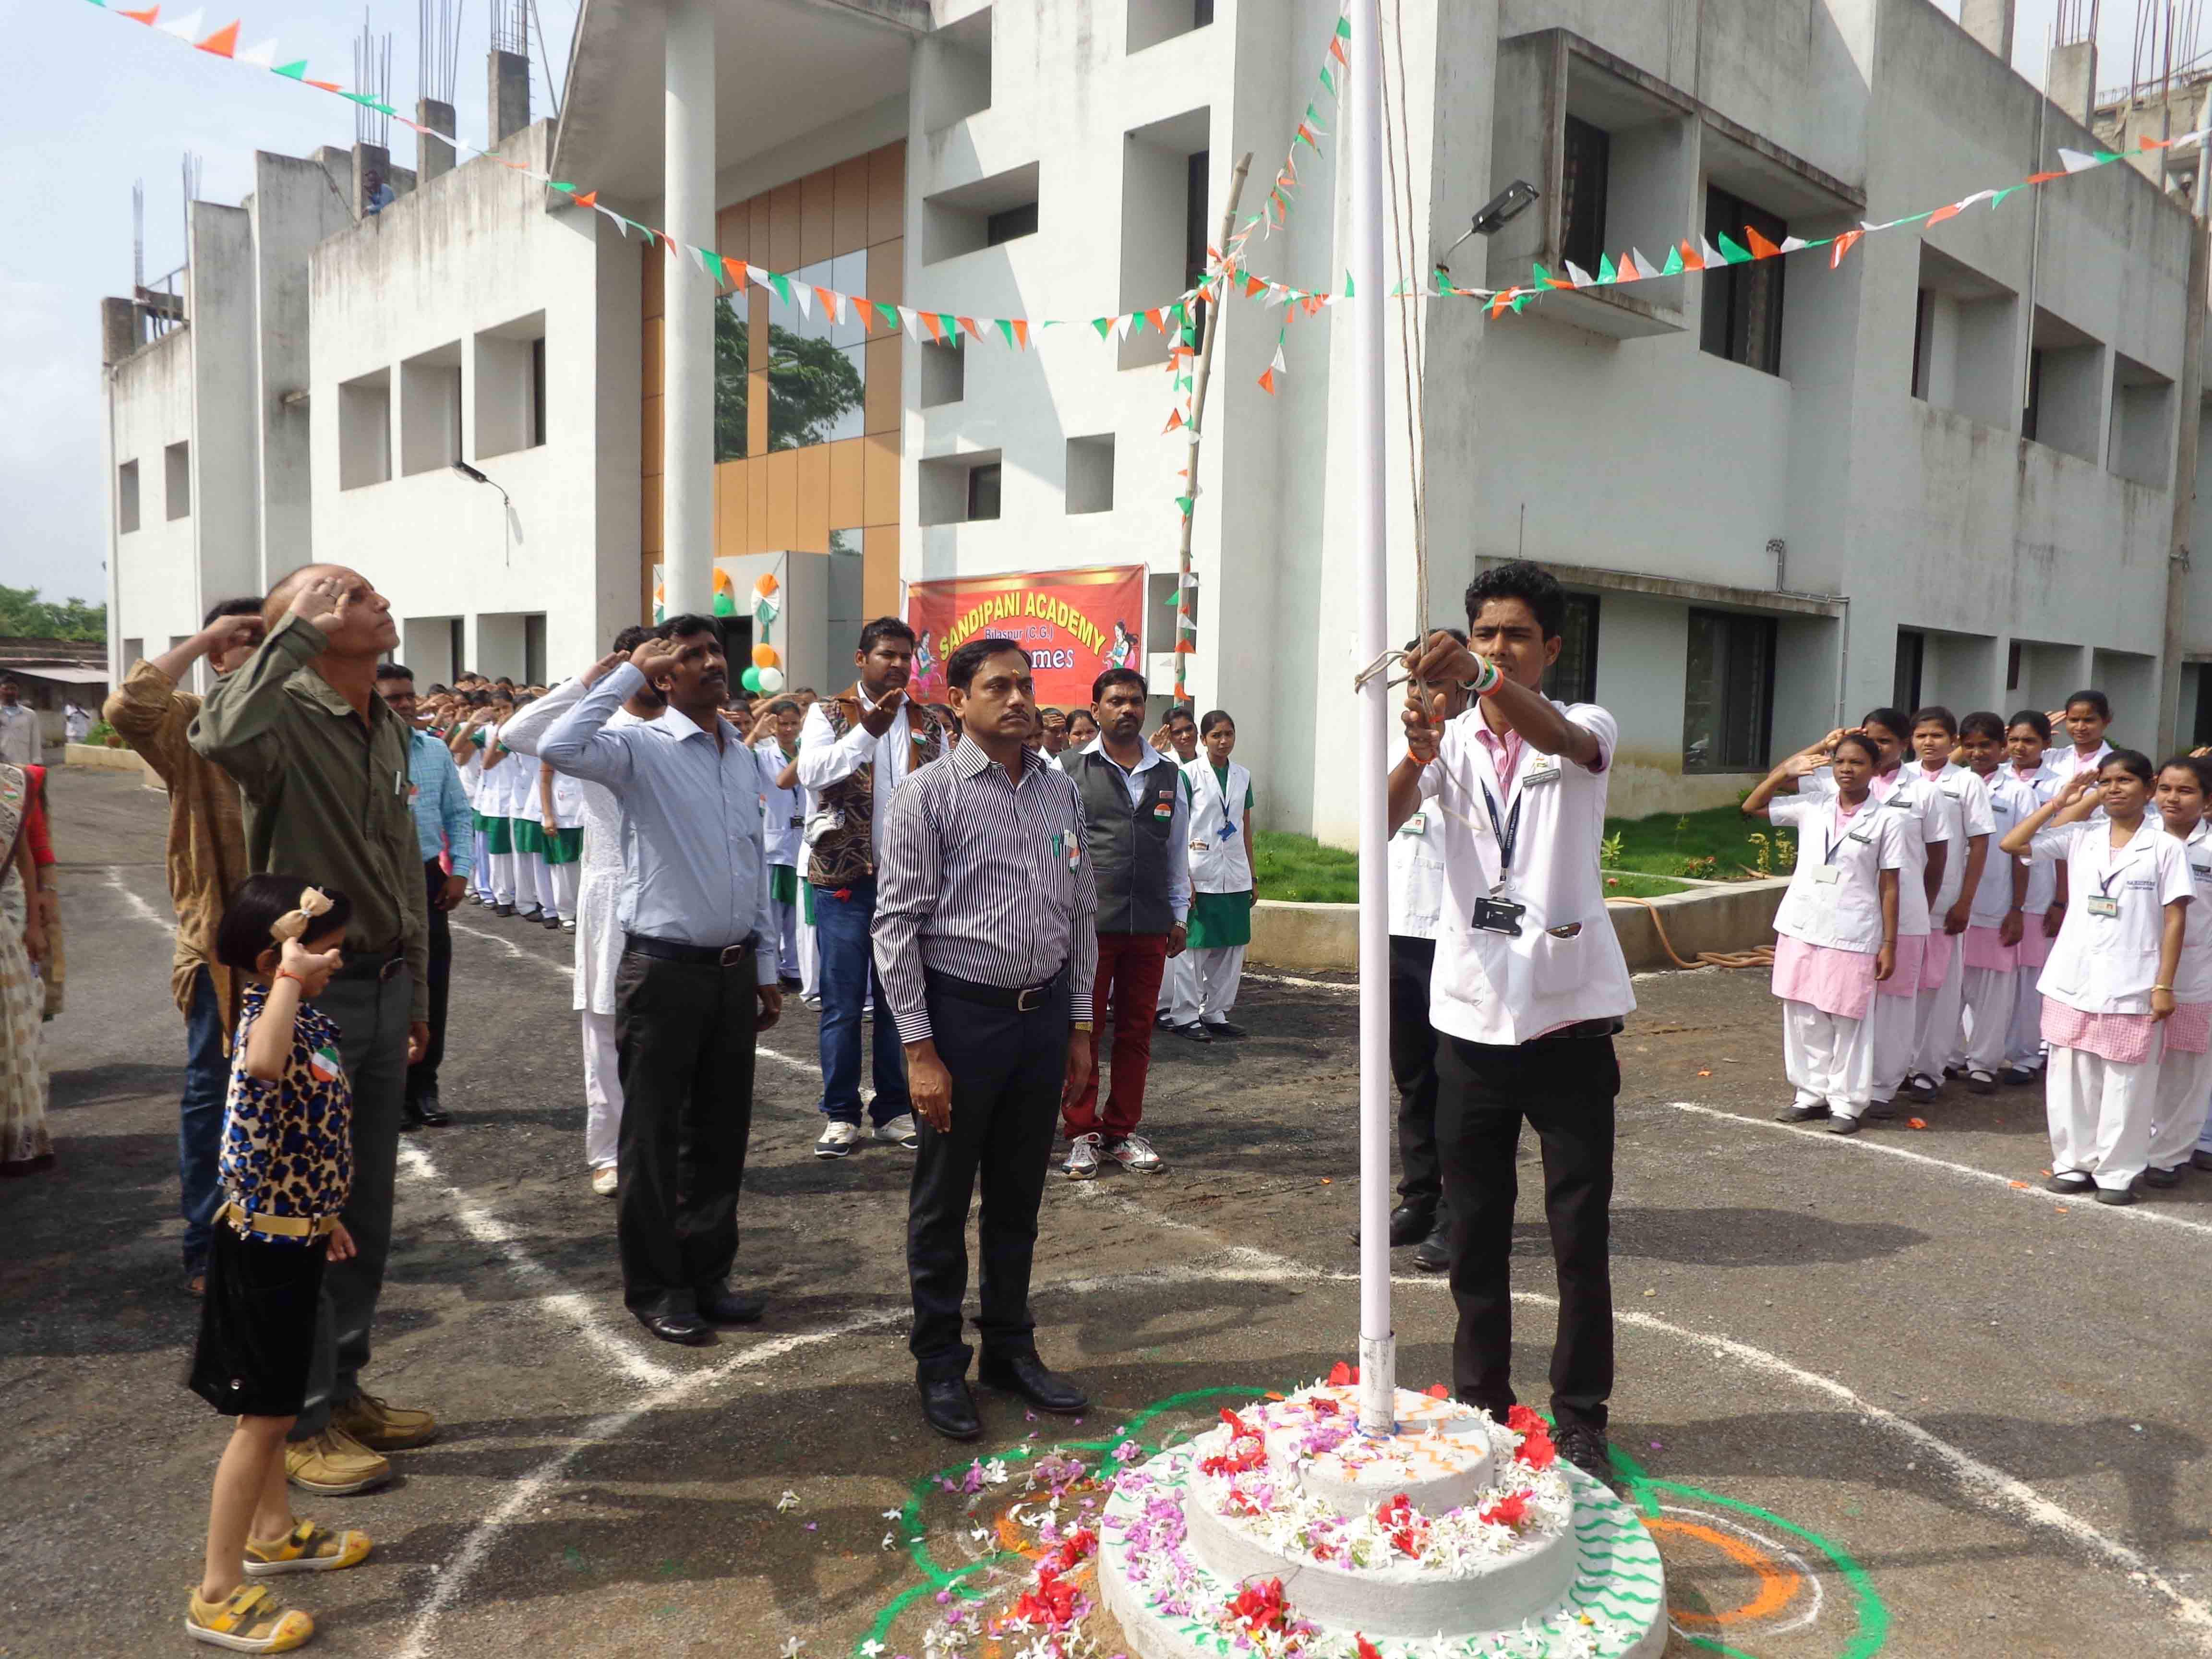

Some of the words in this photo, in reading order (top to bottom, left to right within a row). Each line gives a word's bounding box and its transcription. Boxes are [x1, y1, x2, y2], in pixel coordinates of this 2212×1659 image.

[939, 591, 1021, 661] SANDIPANI
[1025, 591, 1106, 657] ACADEMY
[985, 628, 1023, 640] Bilaspur
[1025, 625, 1053, 642] (C.G.)
